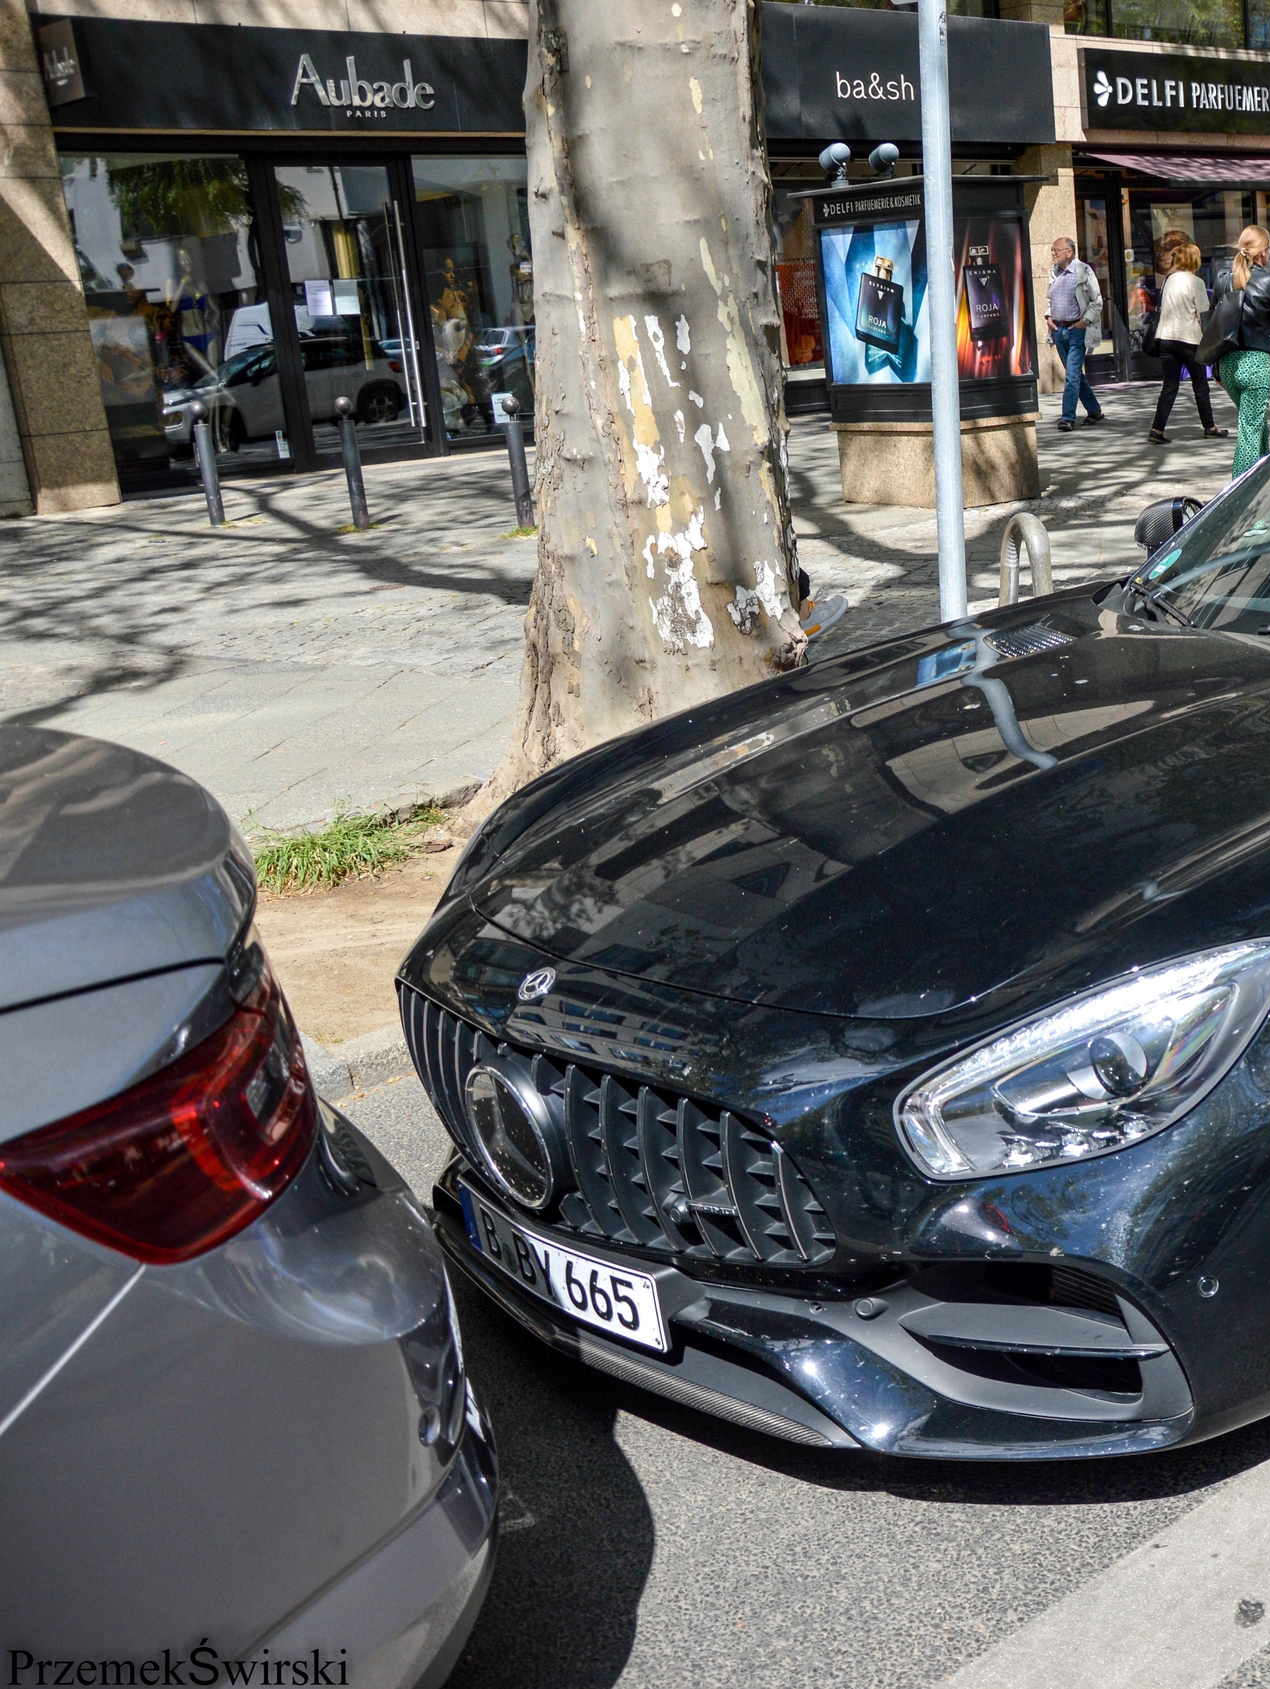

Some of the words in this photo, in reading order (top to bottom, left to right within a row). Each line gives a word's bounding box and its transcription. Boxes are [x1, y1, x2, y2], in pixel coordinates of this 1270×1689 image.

[291, 53, 435, 110] Aubade
[836, 71, 914, 100] ba&sh
[1116, 76, 1184, 108] DELFI
[346, 110, 387, 118] PARIS
[829, 202, 853, 215] DELFI
[868, 280, 895, 294] ELYSIUM
[976, 302, 999, 312] ROJA
[868, 314, 887, 328] ROJA
[479, 1204, 502, 1261] B
[511, 1229, 555, 1297] BY
[566, 1260, 640, 1331] 665
